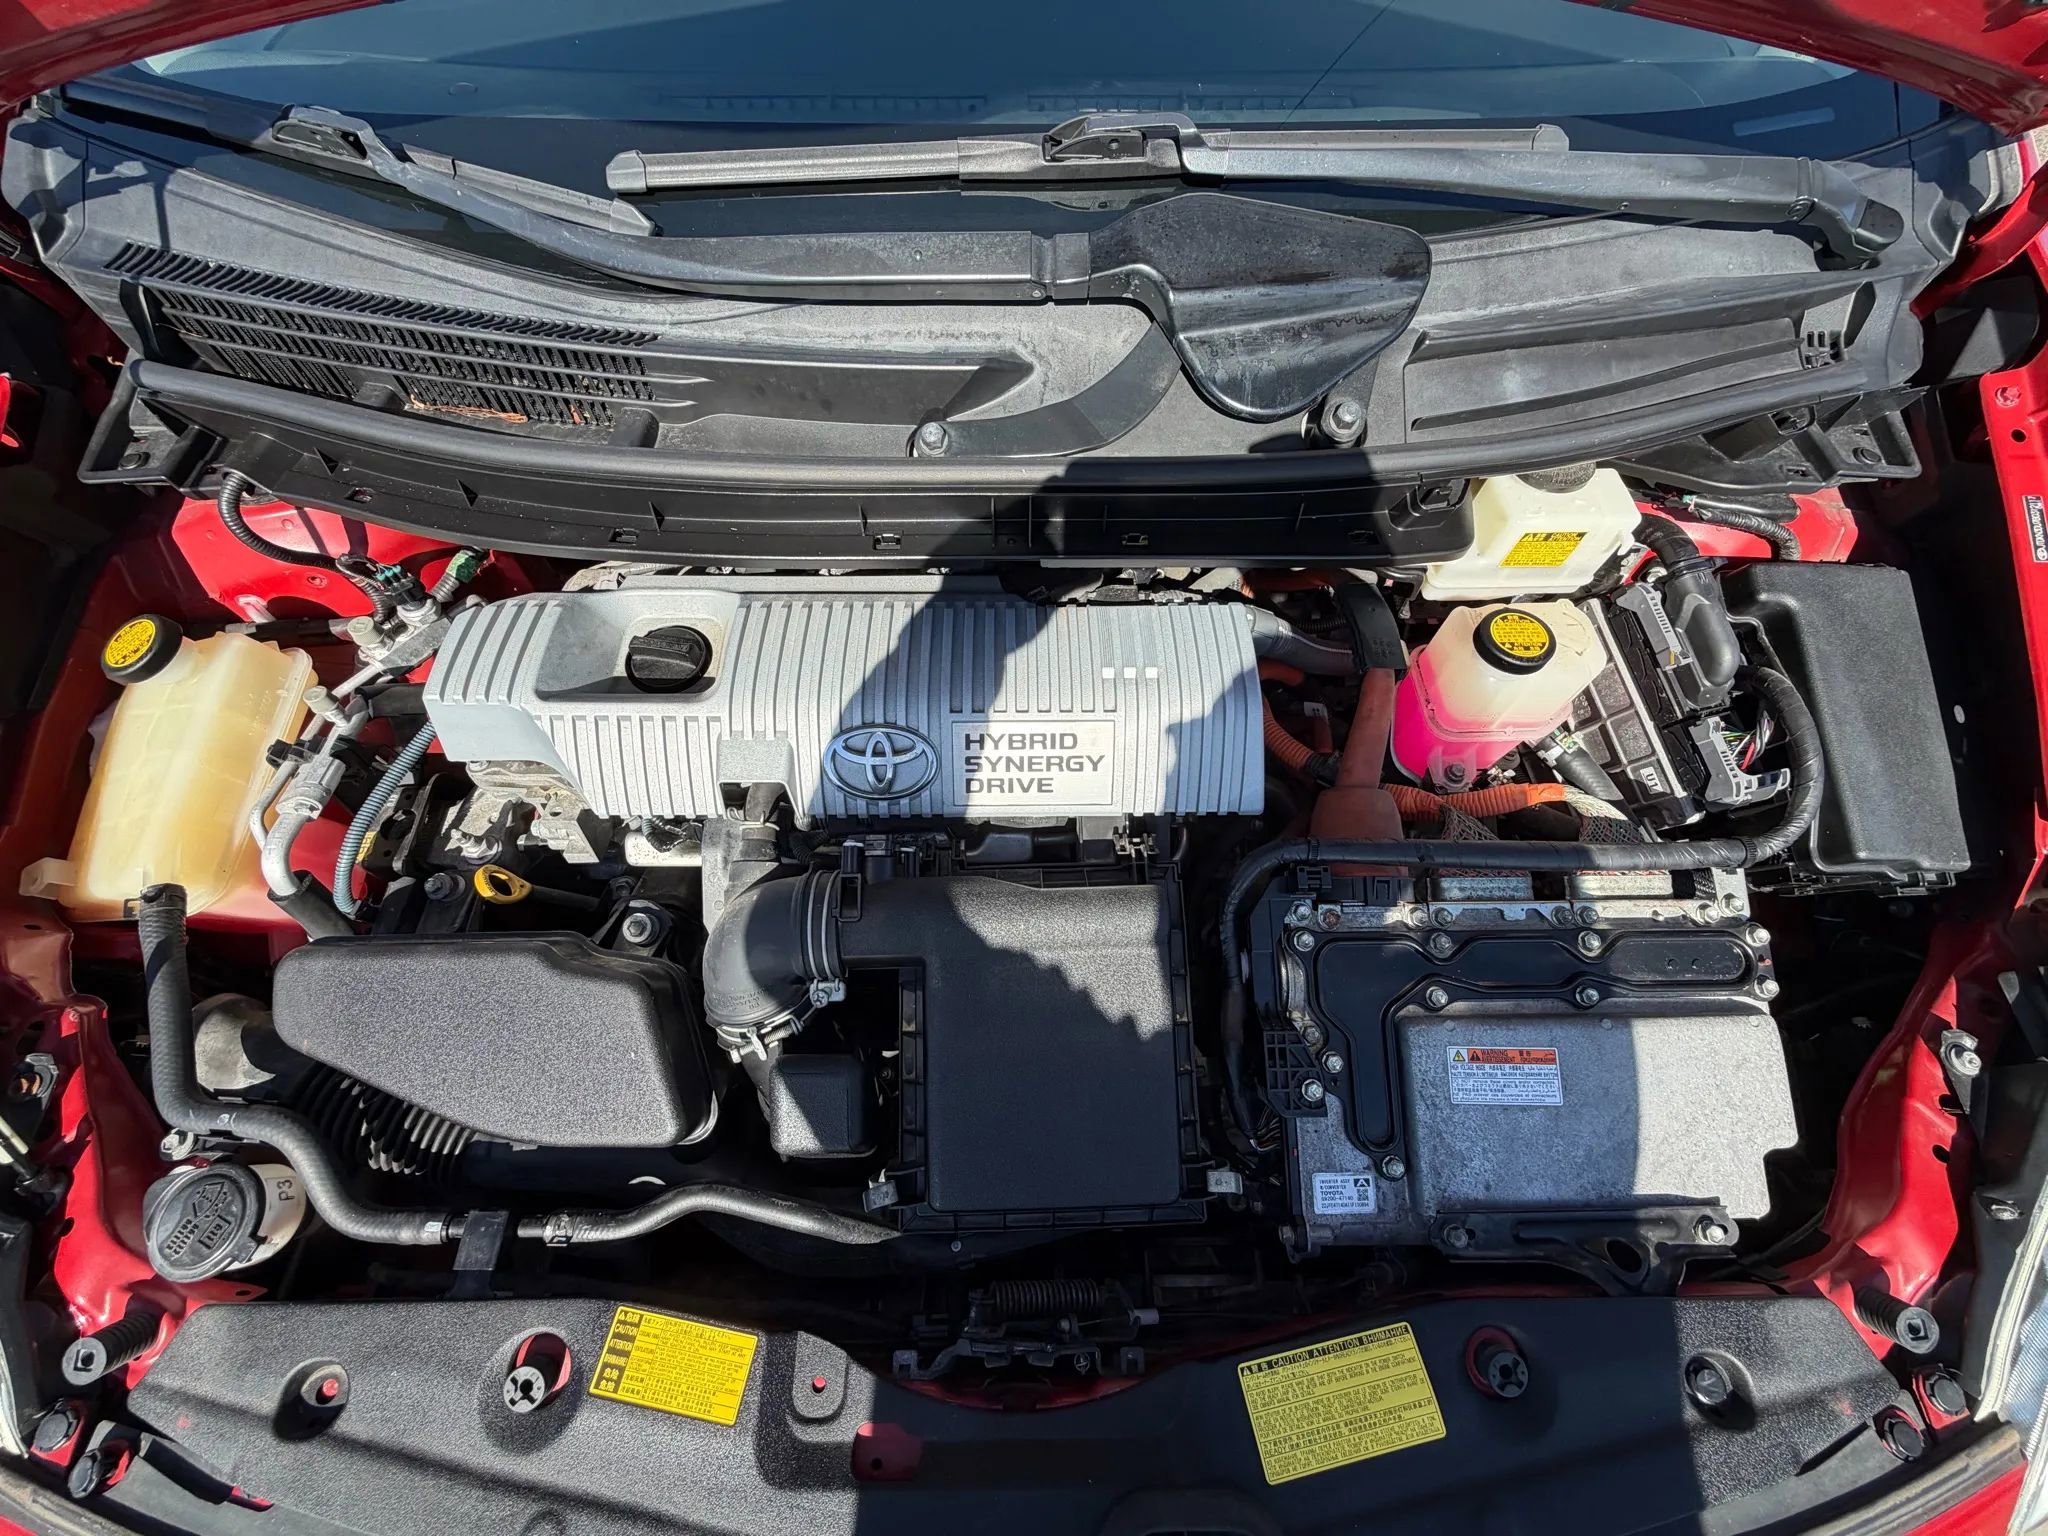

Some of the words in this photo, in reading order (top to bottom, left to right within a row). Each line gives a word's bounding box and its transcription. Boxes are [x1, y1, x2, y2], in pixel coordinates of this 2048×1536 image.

[965, 733, 1077, 750] HYBRID
[965, 755, 1105, 772] SYNERGY
[965, 777, 1054, 793] DRIVE
[1645, 773, 1659, 793] U1
[277, 1179, 295, 1202] P3
[614, 1323, 638, 1336] CAUTION
[609, 1339, 633, 1351] ATTENTION
[1271, 1353, 1310, 1368] CAUTION
[1312, 1339, 1360, 1357] ATTENTION
[1362, 1326, 1408, 1344] ВНИМАНИЕ
